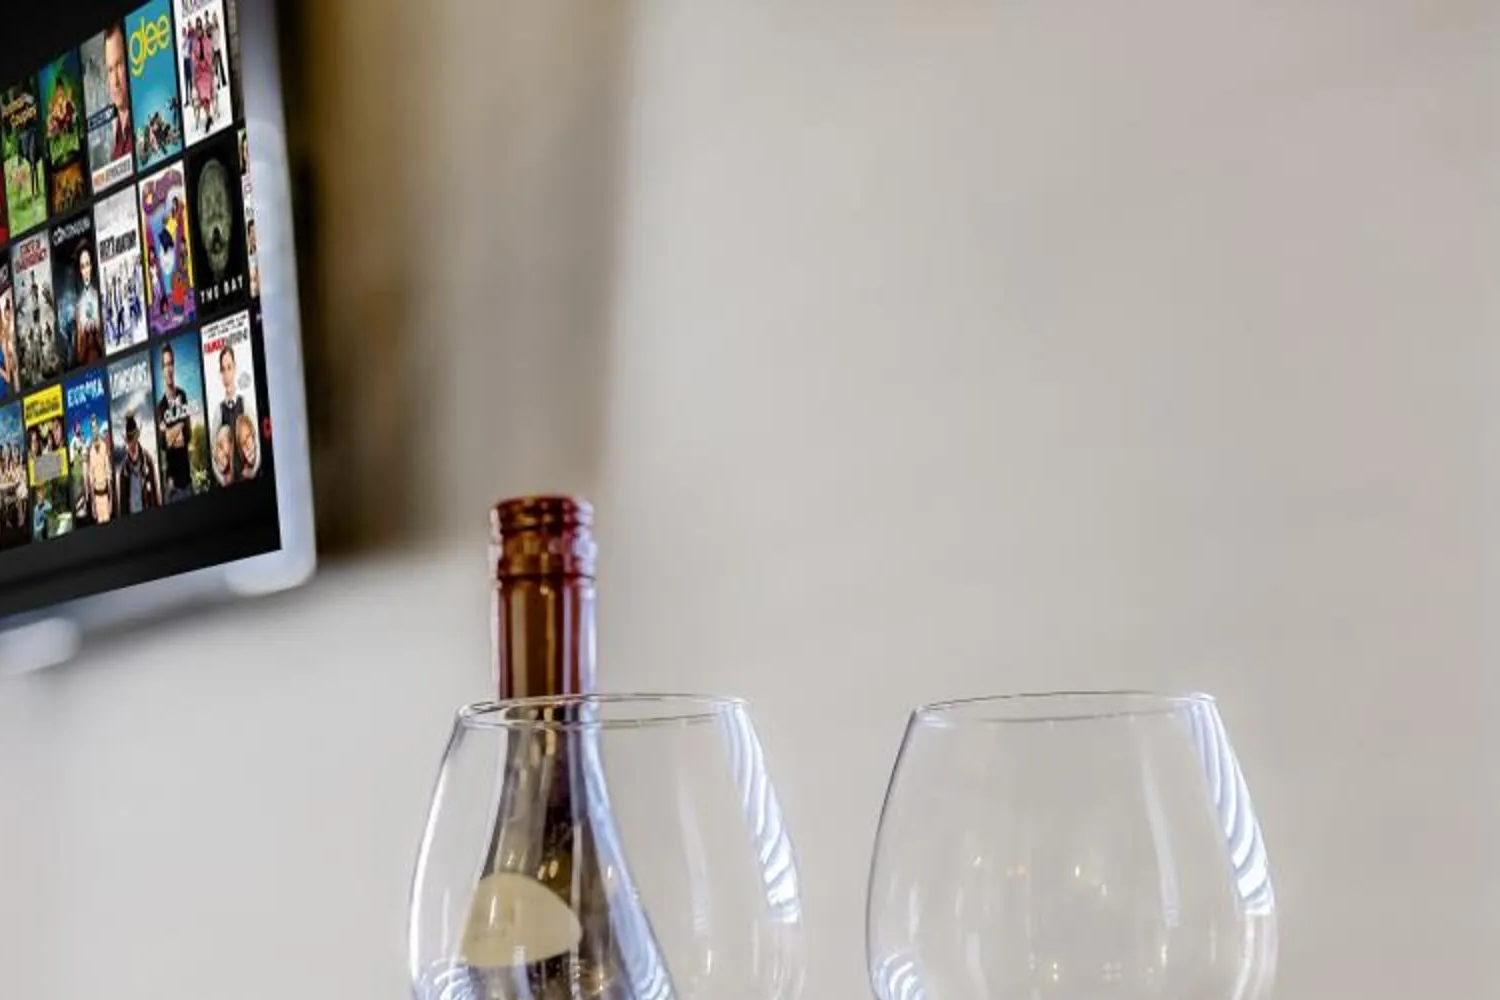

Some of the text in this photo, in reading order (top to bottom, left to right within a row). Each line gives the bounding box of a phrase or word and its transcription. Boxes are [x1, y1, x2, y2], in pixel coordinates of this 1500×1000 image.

[129, 14, 170, 77] glee
[200, 273, 244, 305] THE BAY
